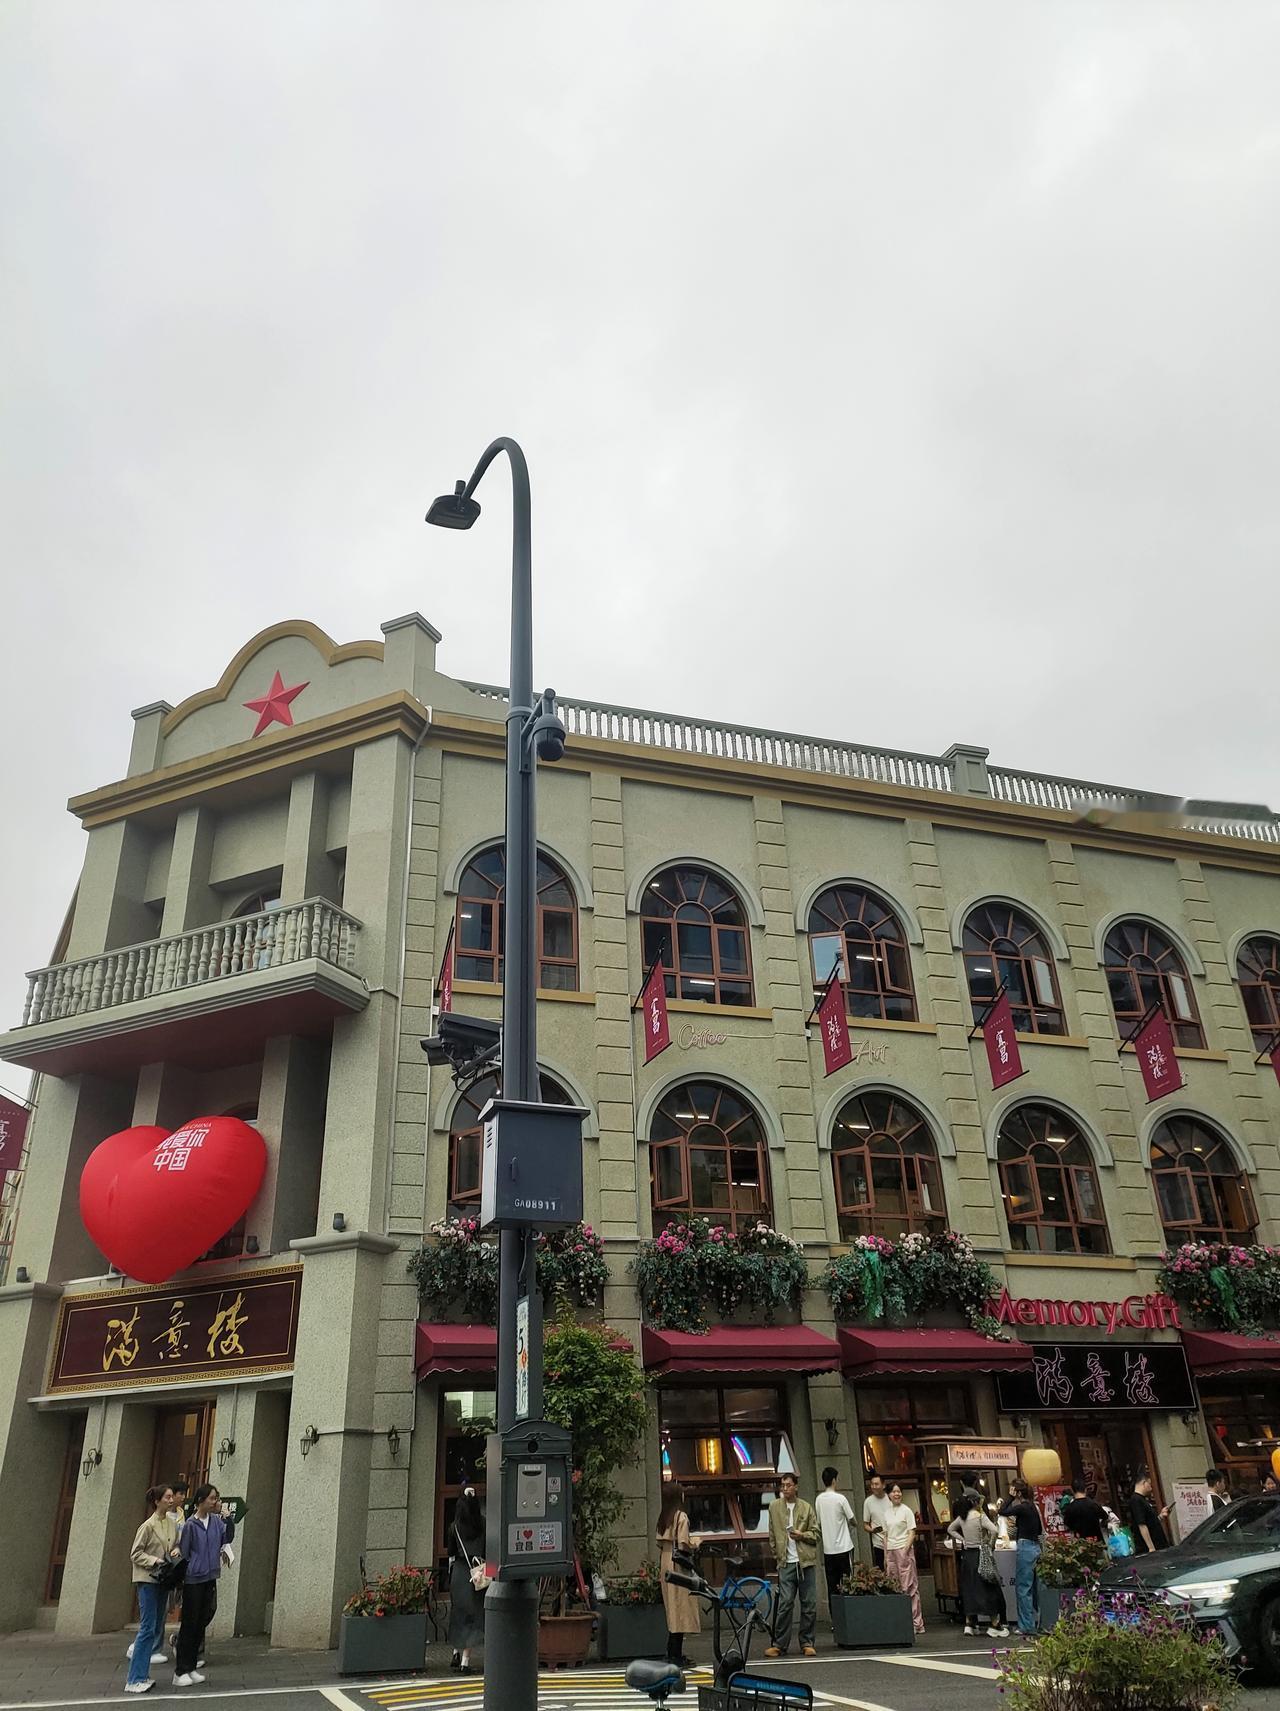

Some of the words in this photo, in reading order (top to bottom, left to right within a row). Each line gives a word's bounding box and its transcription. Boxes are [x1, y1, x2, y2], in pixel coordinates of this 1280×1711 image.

[678, 1023, 727, 1050] Coffee
[153, 1147, 192, 1171] 中国
[514, 1198, 556, 1211] GA08911
[515, 1541, 533, 1552] 宜昌
